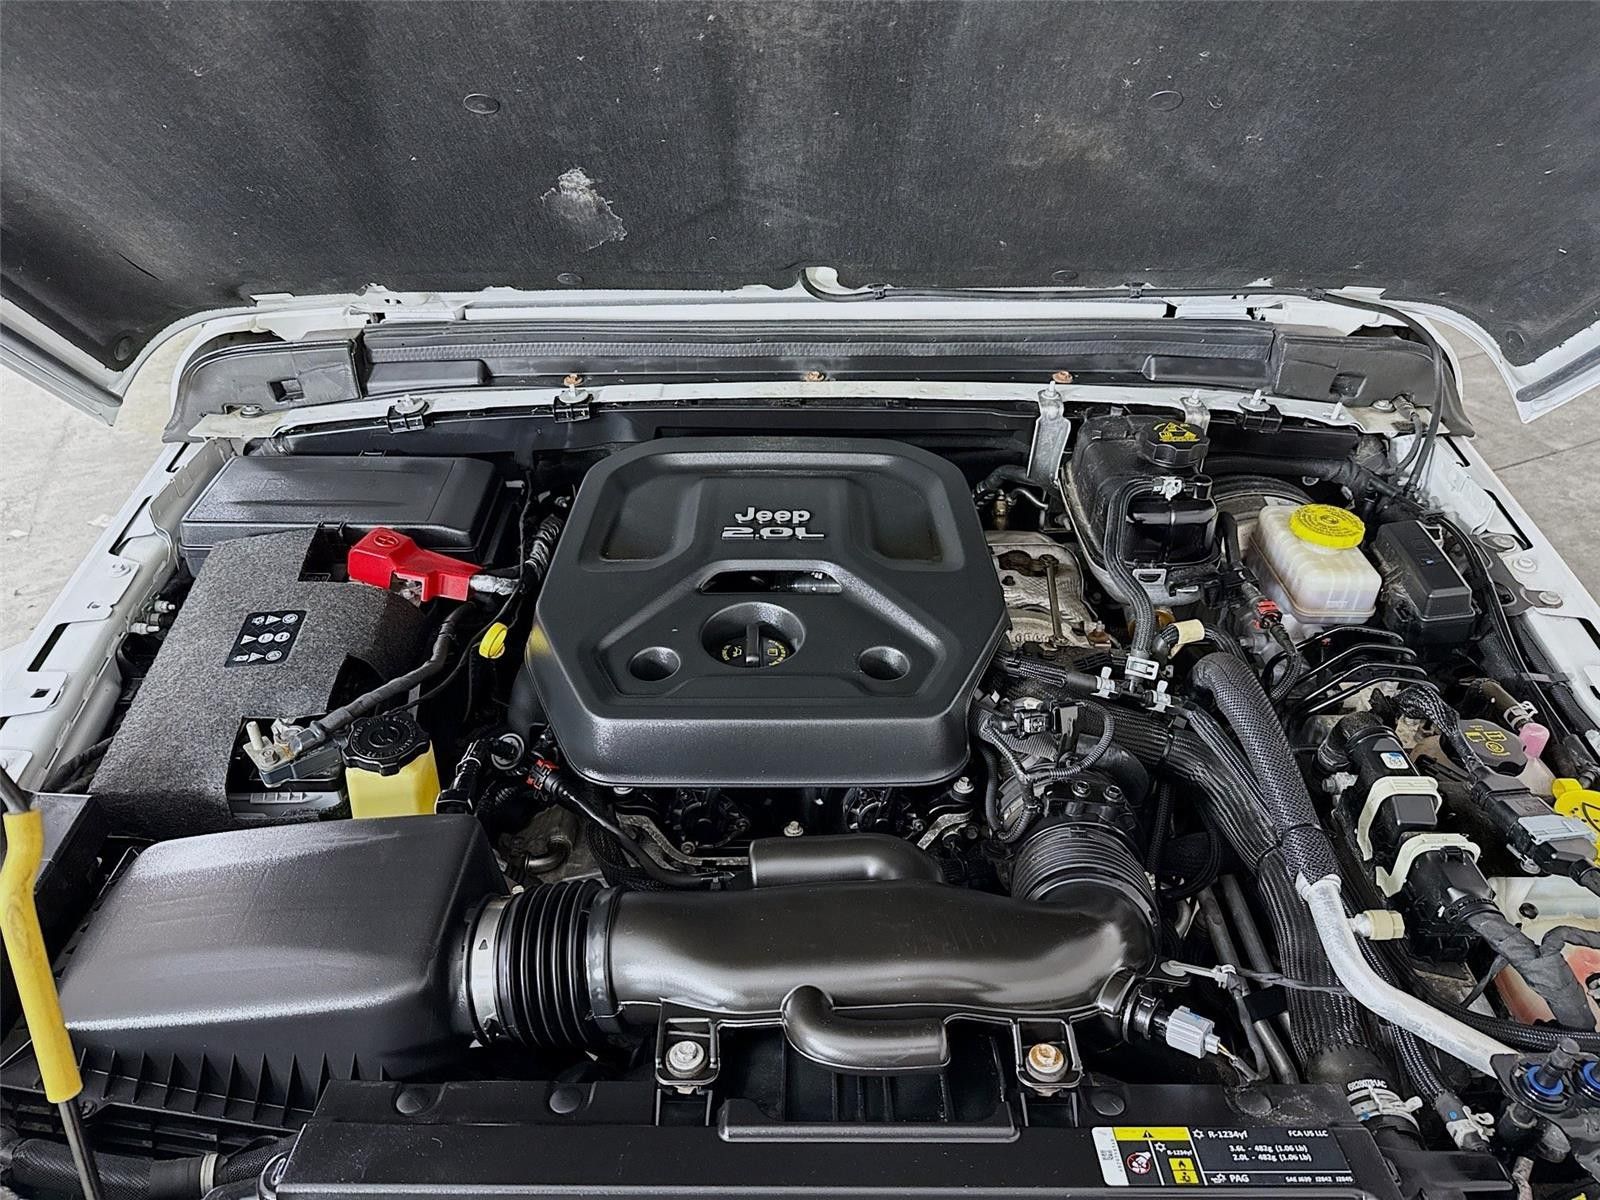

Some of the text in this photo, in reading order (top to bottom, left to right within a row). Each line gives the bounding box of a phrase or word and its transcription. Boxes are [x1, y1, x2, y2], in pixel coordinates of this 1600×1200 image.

[735, 506, 811, 524] Jeep
[721, 526, 825, 541] 2.0L
[1287, 1129, 1329, 1137] FCA US LLC
[1229, 1174, 1250, 1183] PAG
